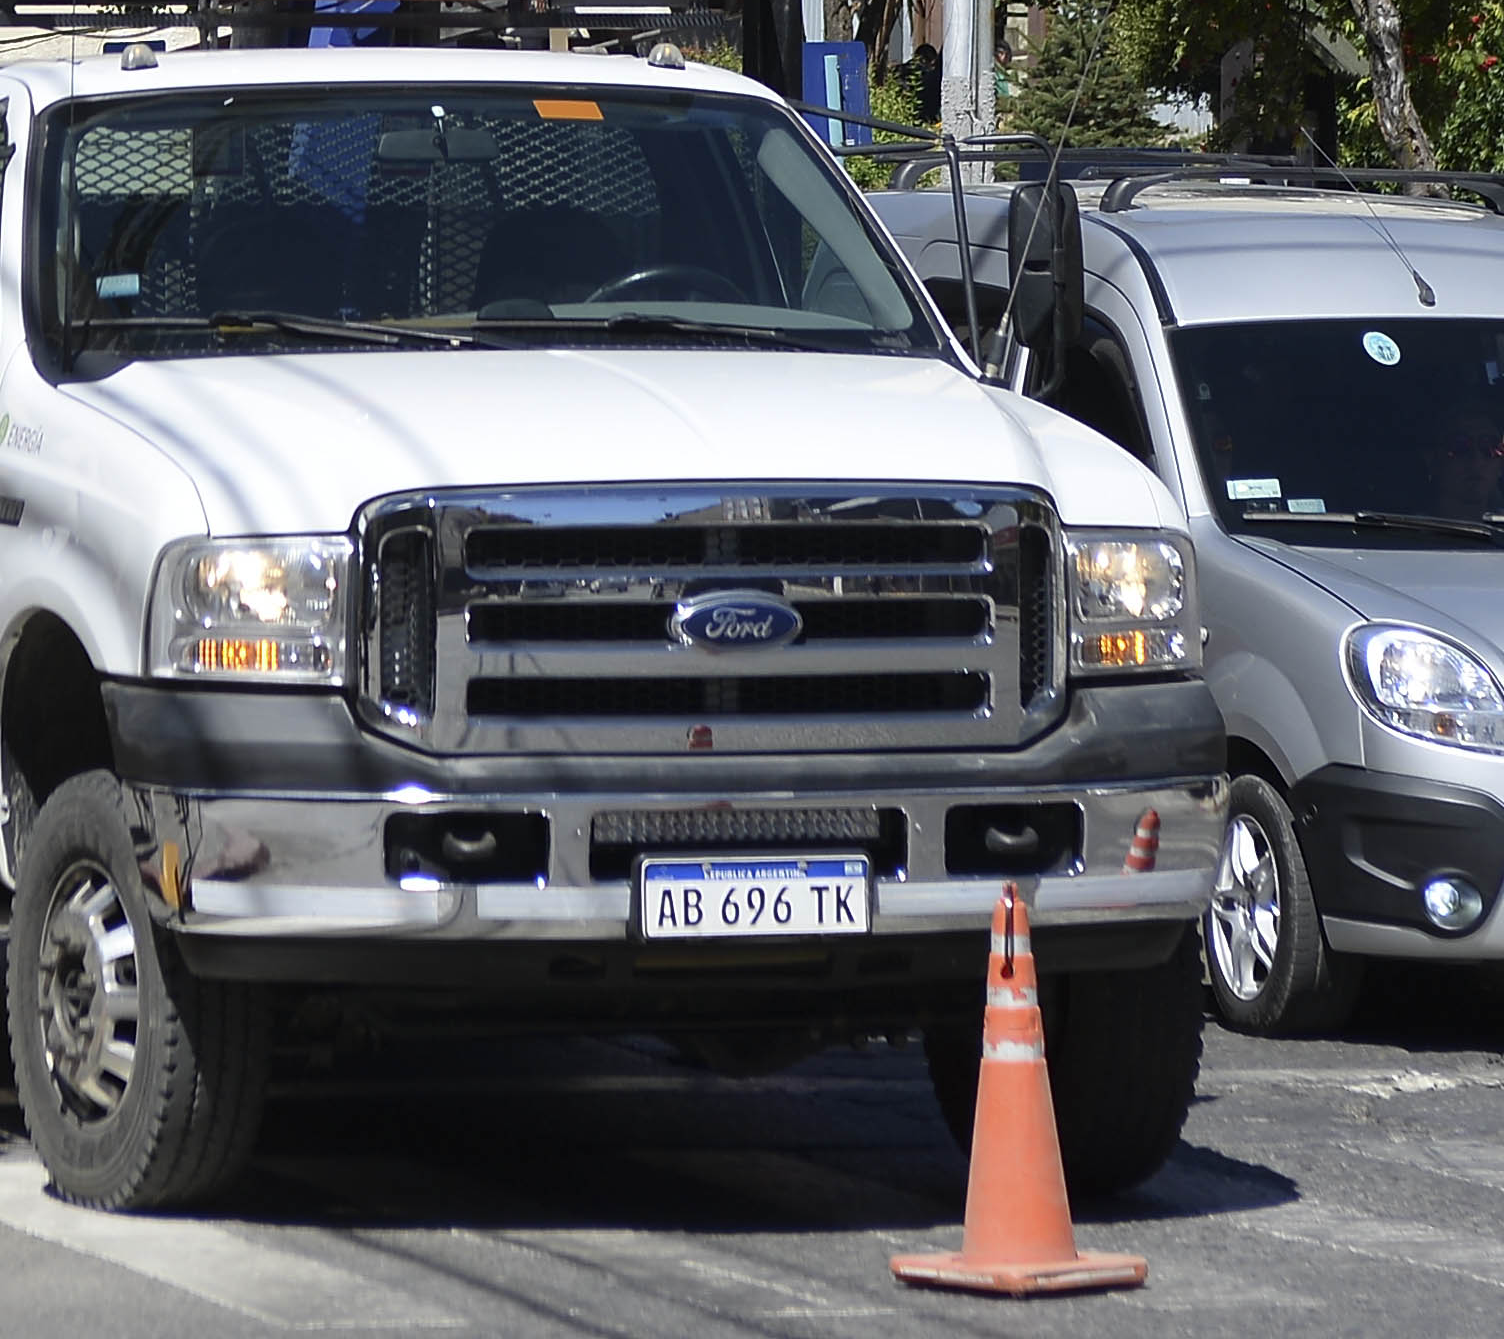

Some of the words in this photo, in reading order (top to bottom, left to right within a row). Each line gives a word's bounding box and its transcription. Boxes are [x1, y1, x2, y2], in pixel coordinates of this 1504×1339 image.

[705, 606, 774, 639] Ford
[658, 888, 704, 928] AB
[721, 886, 792, 926] 696
[810, 884, 855, 924] TK
